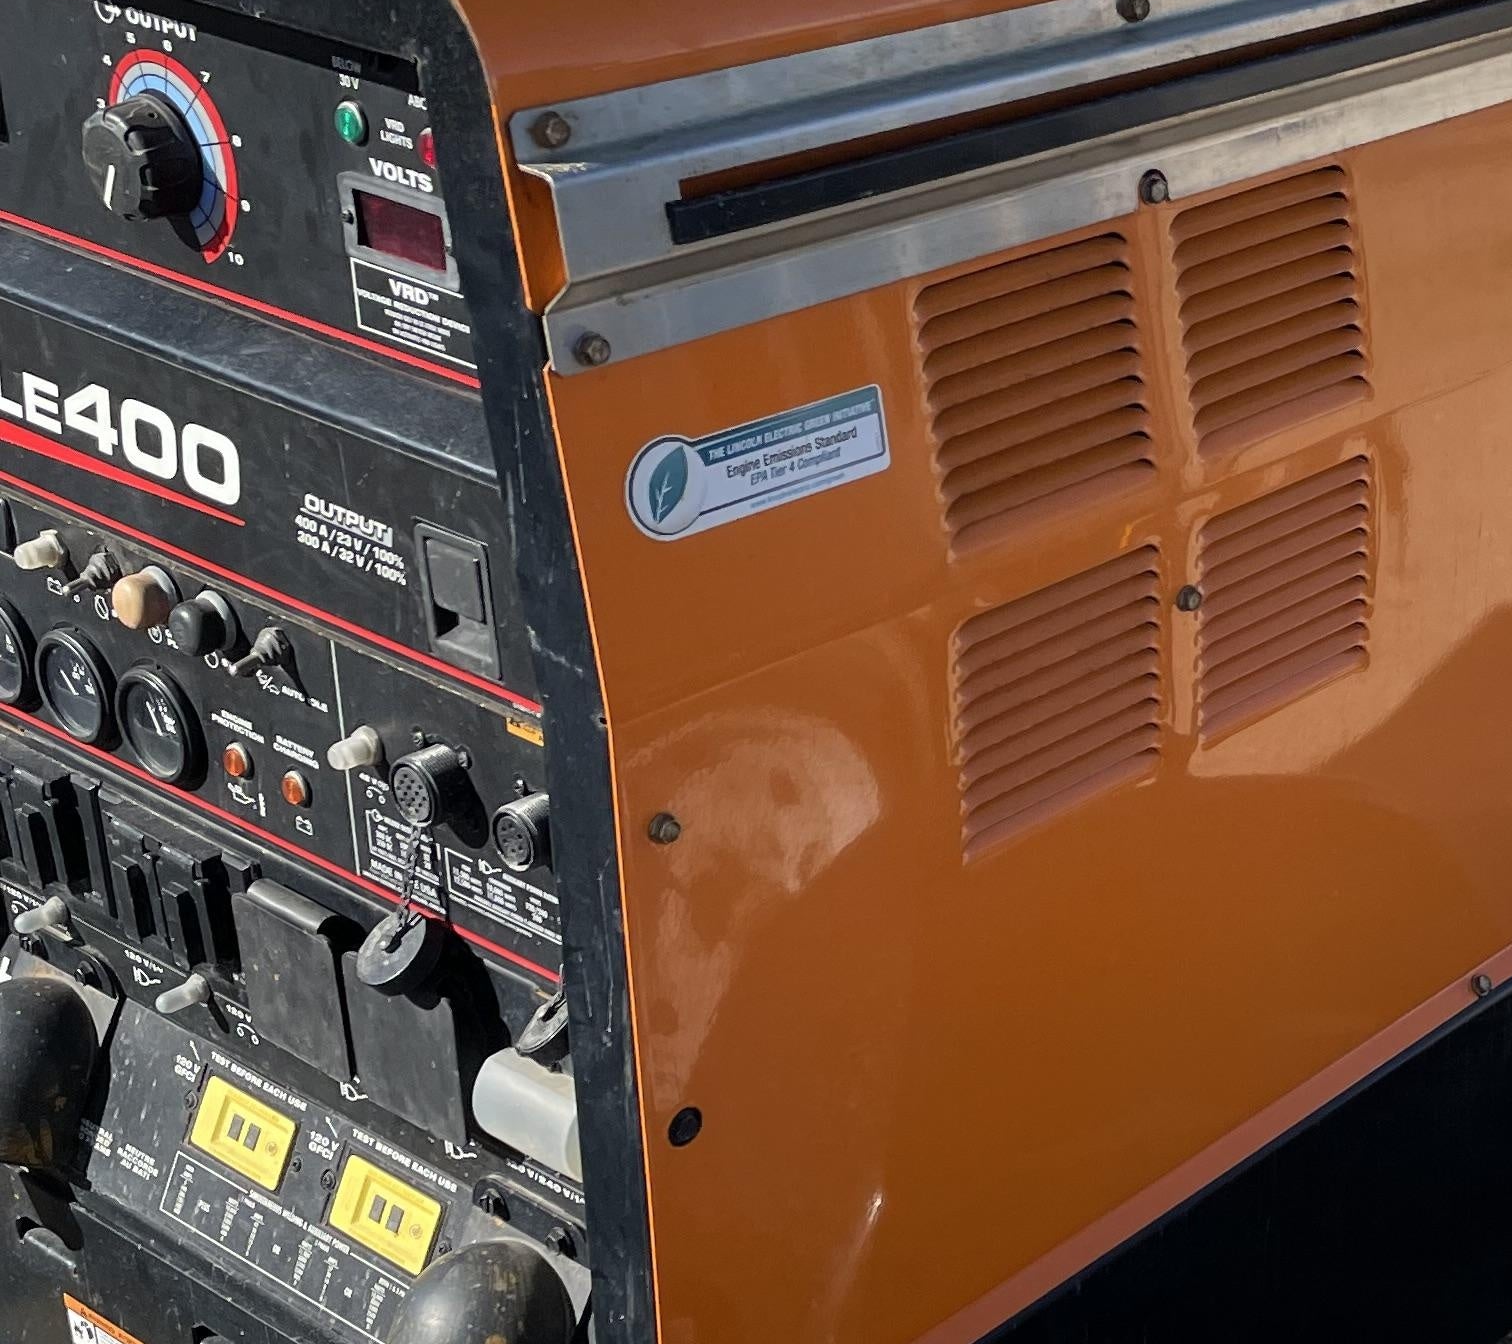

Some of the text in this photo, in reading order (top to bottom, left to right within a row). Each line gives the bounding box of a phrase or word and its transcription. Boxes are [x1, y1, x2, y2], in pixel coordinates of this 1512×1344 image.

[124, 6, 197, 42] OUTPUT
[368, 157, 434, 193] VOLTS
[727, 425, 858, 479] Engine Emissions Standard
[750, 472, 768, 487] EPA
[771, 464, 787, 480] Tier
[304, 493, 387, 539] OUTPUT
[295, 514, 318, 533] 400
[372, 546, 405, 570] 100%
[374, 562, 407, 586] 100%
[175, 1054, 194, 1071] 120
[211, 1050, 307, 1112] TEST BEFORE EACH USE
[308, 1140, 335, 1162] GFCI
[310, 1129, 331, 1148] 120
[352, 1127, 458, 1193] TEST BEFORE EACH USE
